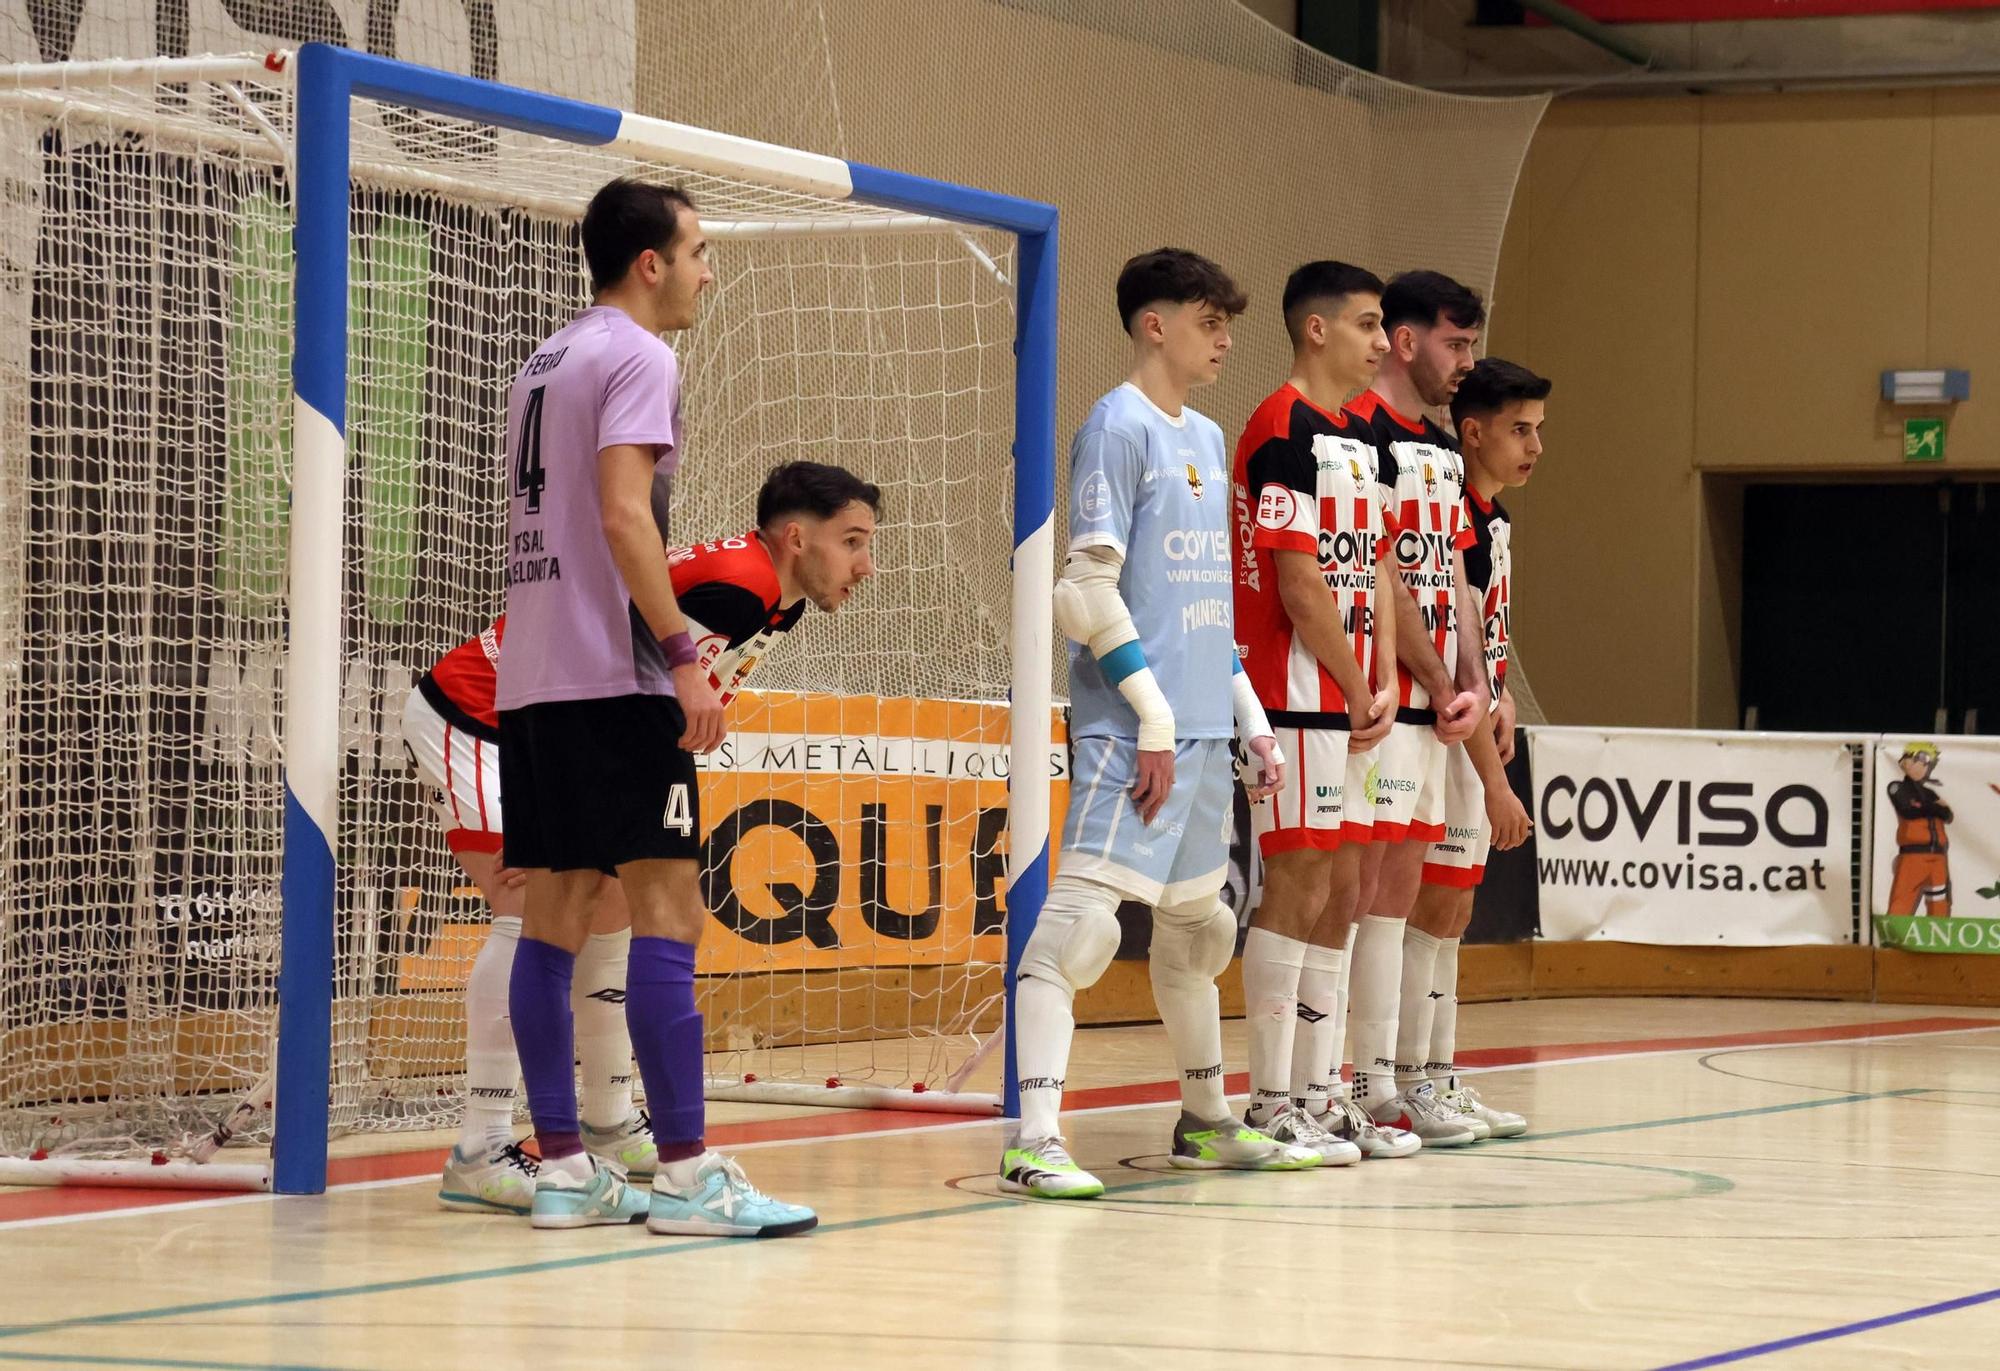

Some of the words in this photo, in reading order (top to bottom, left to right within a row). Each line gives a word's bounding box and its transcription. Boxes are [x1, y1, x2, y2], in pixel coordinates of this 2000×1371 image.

[515, 384, 546, 515] 4
[1260, 508, 1286, 520] EF
[1261, 494, 1287, 507] RF
[663, 784, 693, 837] 4
[1537, 853, 1827, 892] www.covisa.cat
